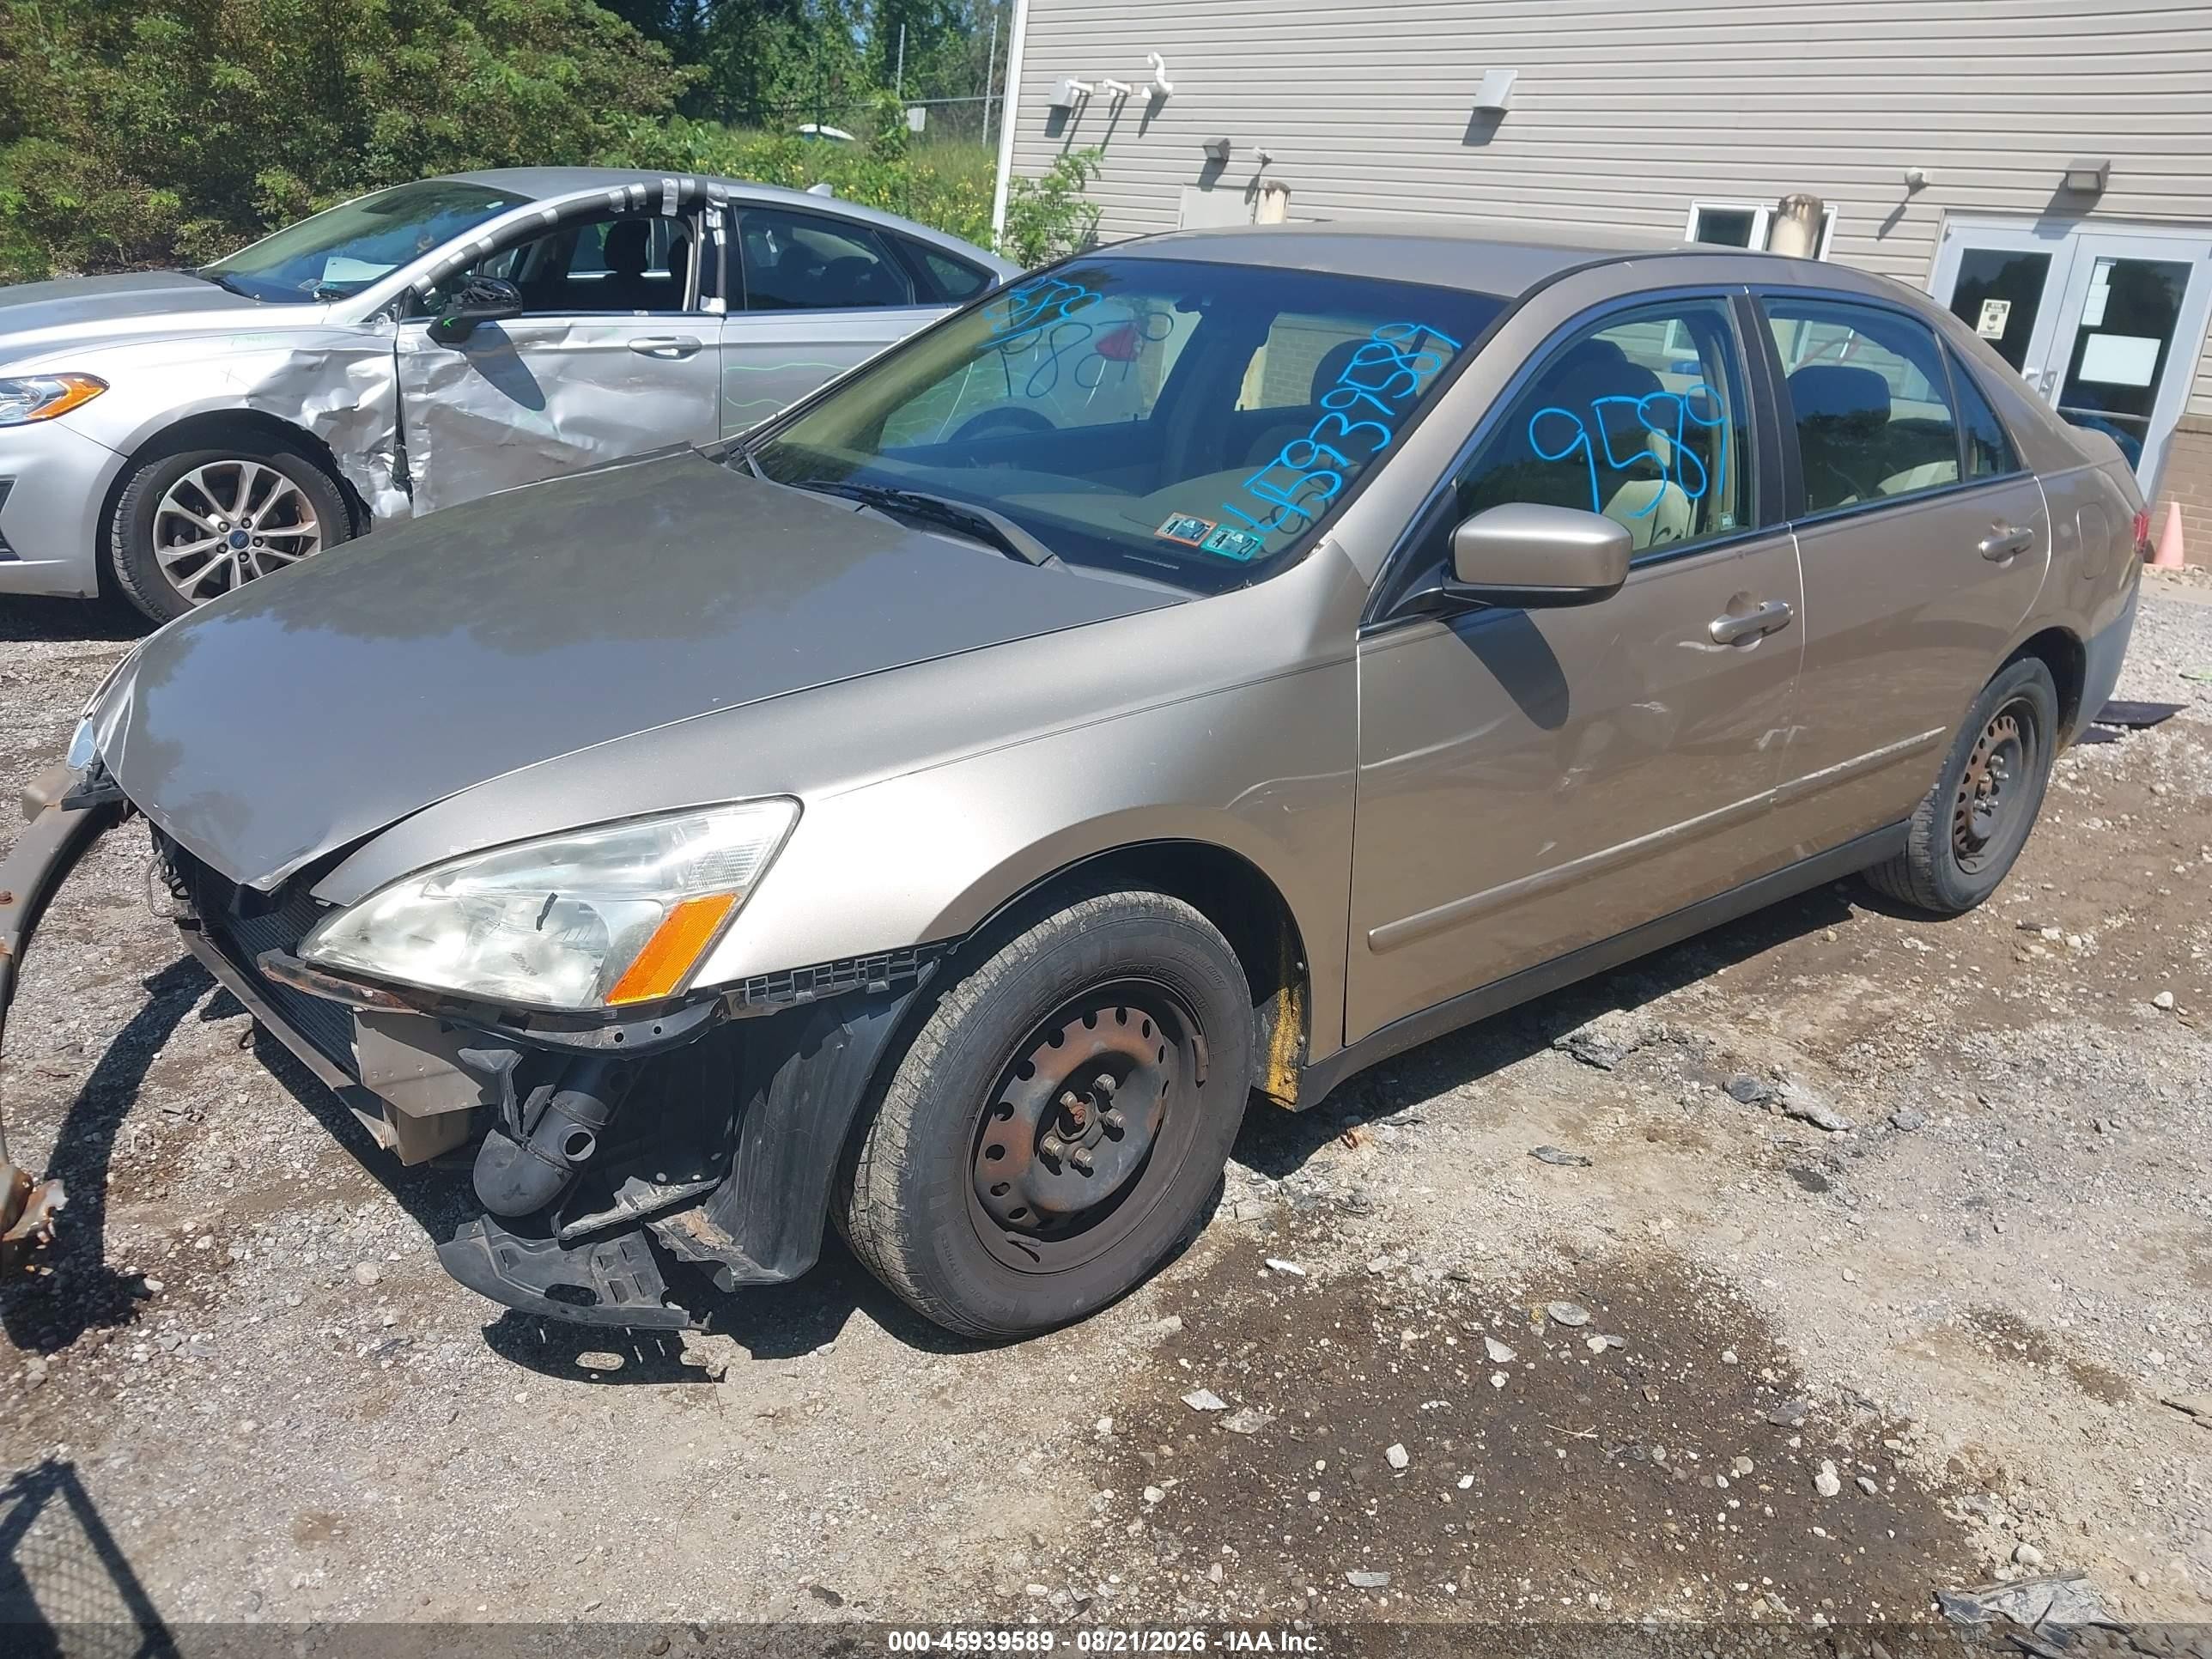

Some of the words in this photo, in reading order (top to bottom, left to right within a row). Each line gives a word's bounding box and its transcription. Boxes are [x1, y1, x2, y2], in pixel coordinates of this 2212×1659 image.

[1222, 323, 1462, 532] 45939589
[1528, 384, 1728, 519] 9589
[1165, 520, 1179, 534] 4
[1214, 533, 1228, 548] 4
[1237, 538, 1258, 556] 27
